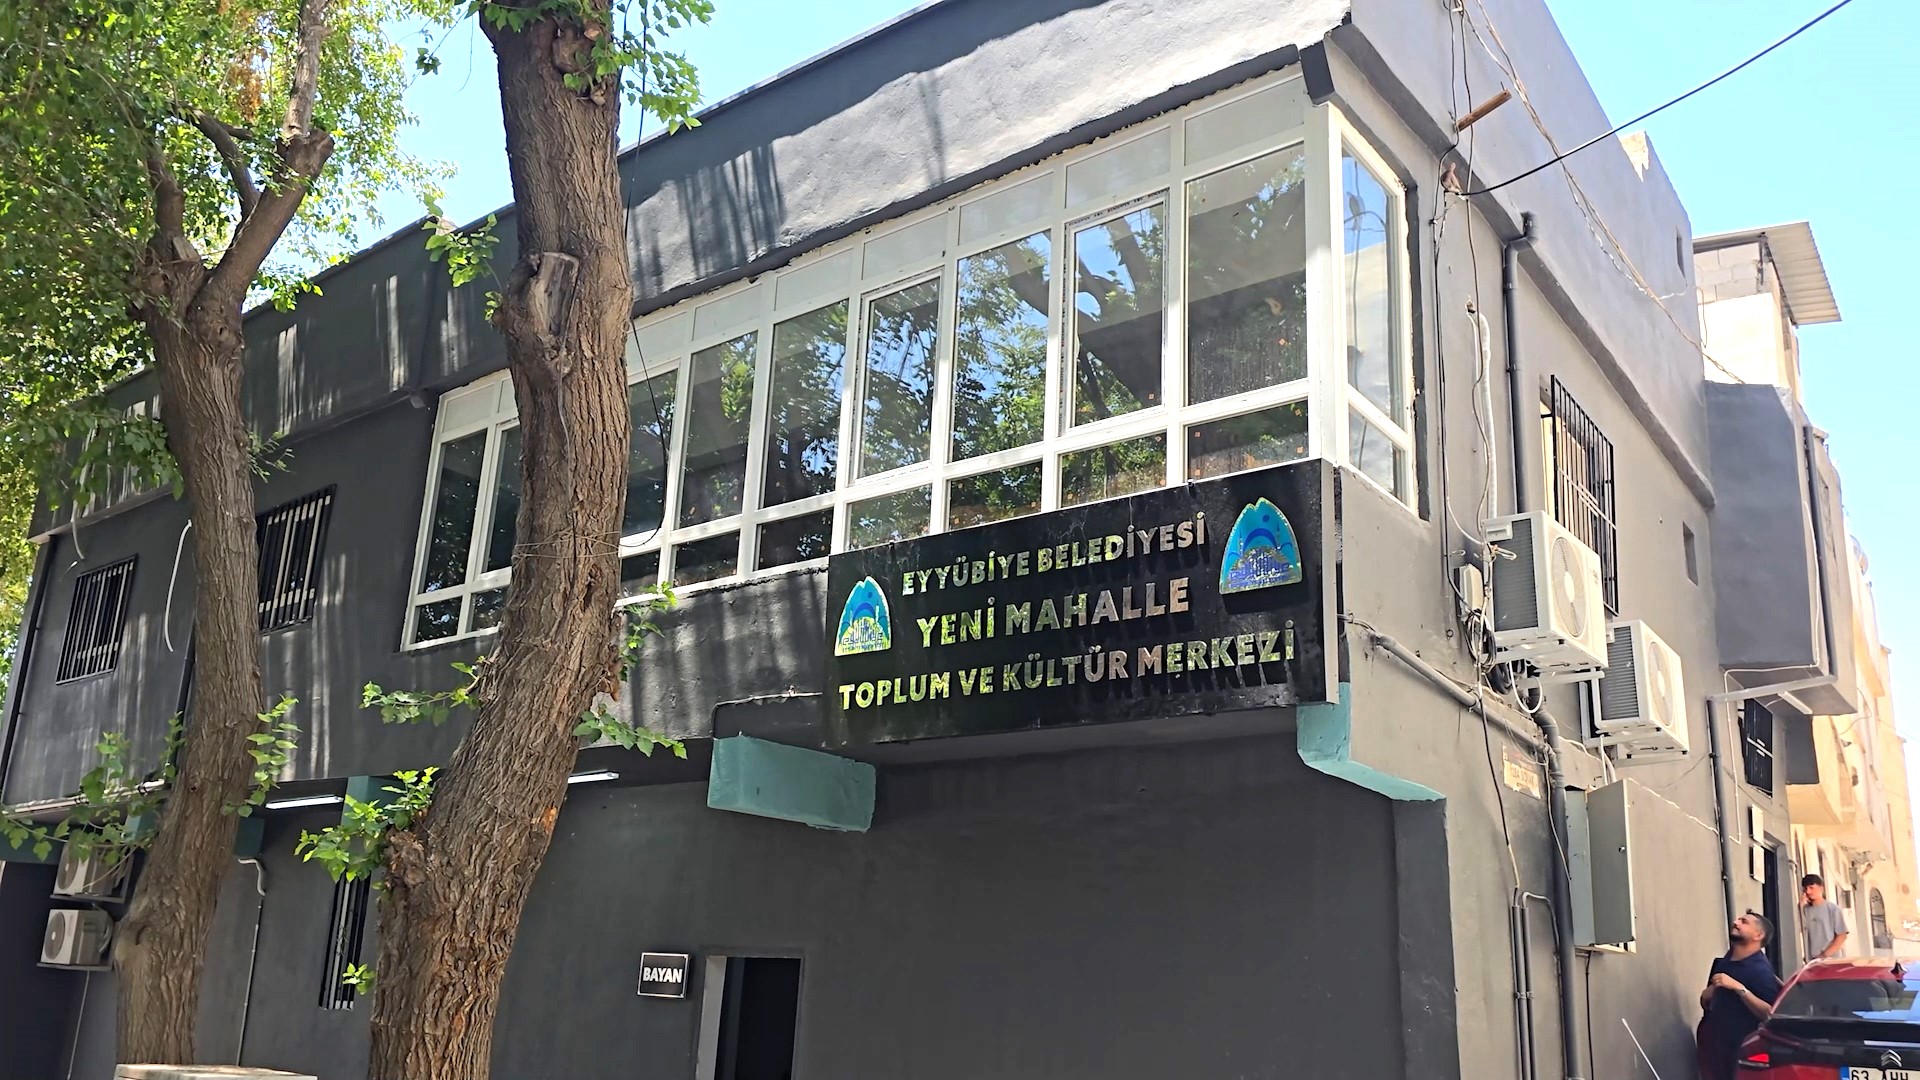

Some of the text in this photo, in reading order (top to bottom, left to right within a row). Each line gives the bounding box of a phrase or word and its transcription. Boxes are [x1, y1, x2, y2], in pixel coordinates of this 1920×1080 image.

[902, 511, 1206, 596] EYYÜBİYE BELEDİYESİ
[916, 577, 1190, 648] YENİ MAHALLE
[838, 619, 1295, 711] TOPLUM VE KÜLTÜR MERKEZİ
[643, 967, 683, 983] BAYAN
[1851, 1069, 1869, 1080] 63
